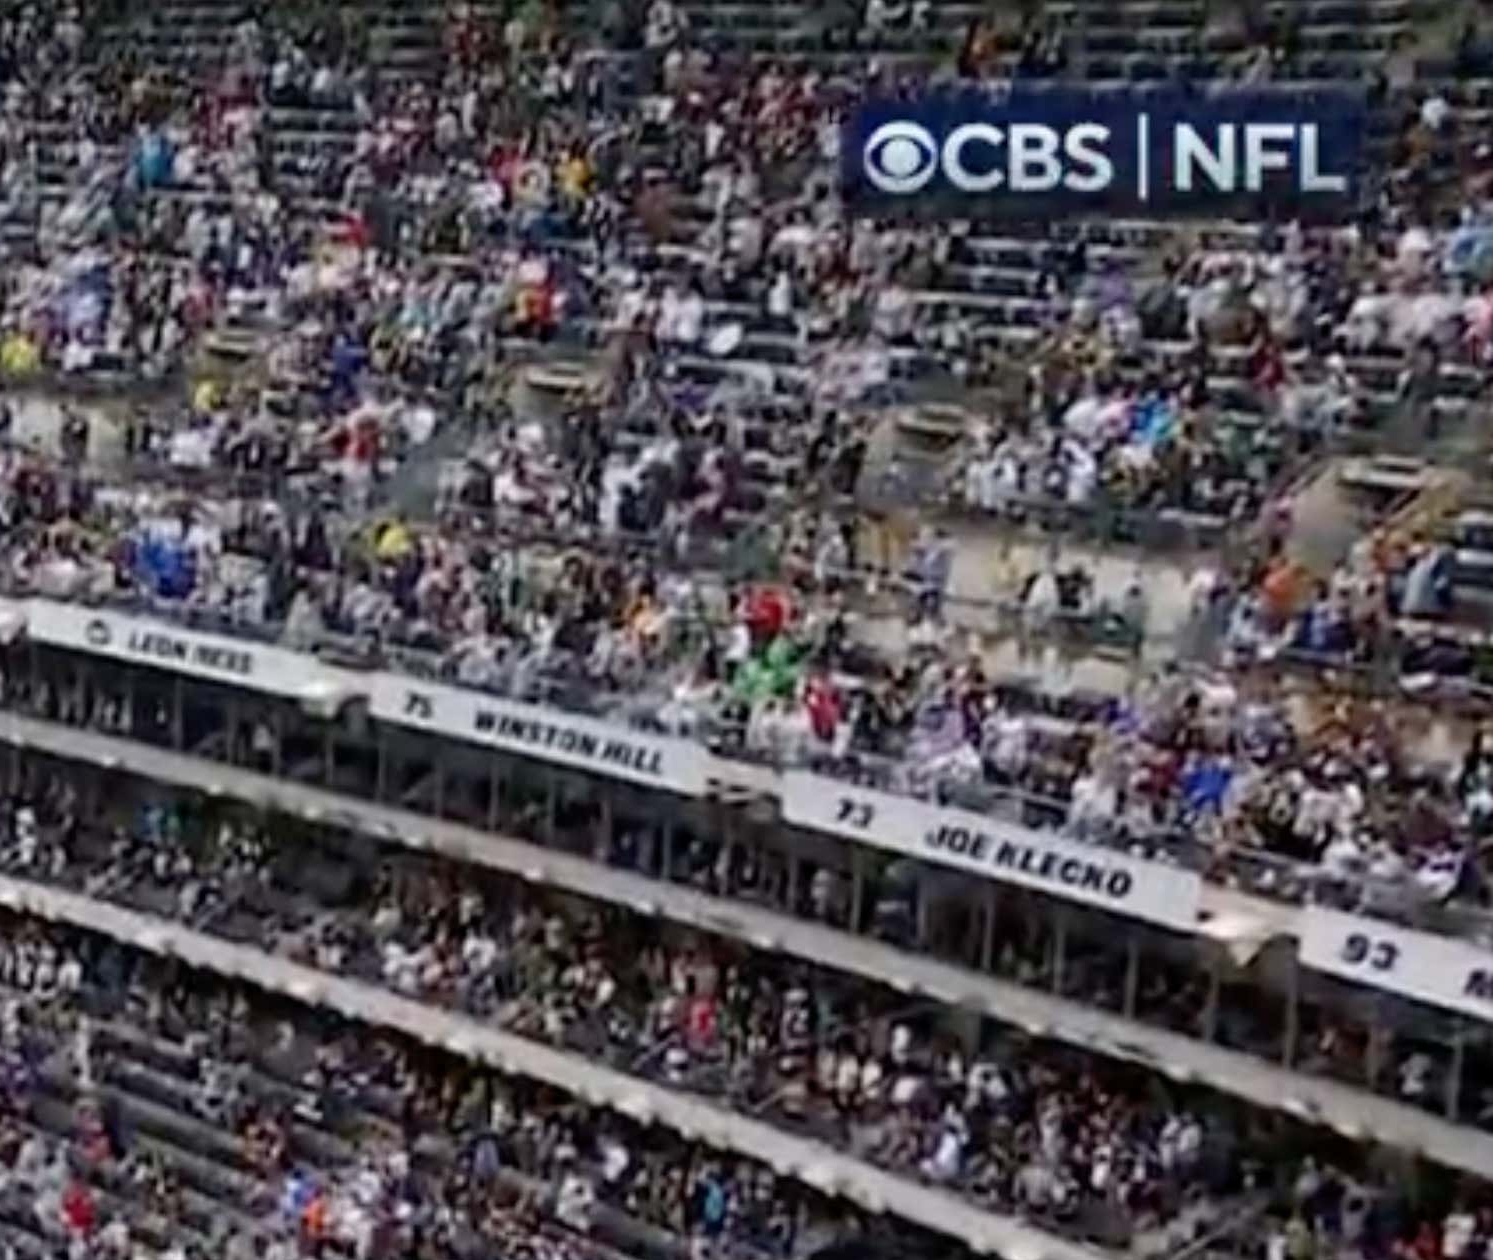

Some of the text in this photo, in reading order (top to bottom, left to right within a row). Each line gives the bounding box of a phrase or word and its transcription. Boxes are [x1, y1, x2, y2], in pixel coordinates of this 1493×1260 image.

[128, 630, 189, 661] LEON
[404, 691, 665, 774] 75 WINSTON HILL
[835, 798, 1133, 898] 73 JOE KLECKO
[1340, 932, 1401, 971] 93
